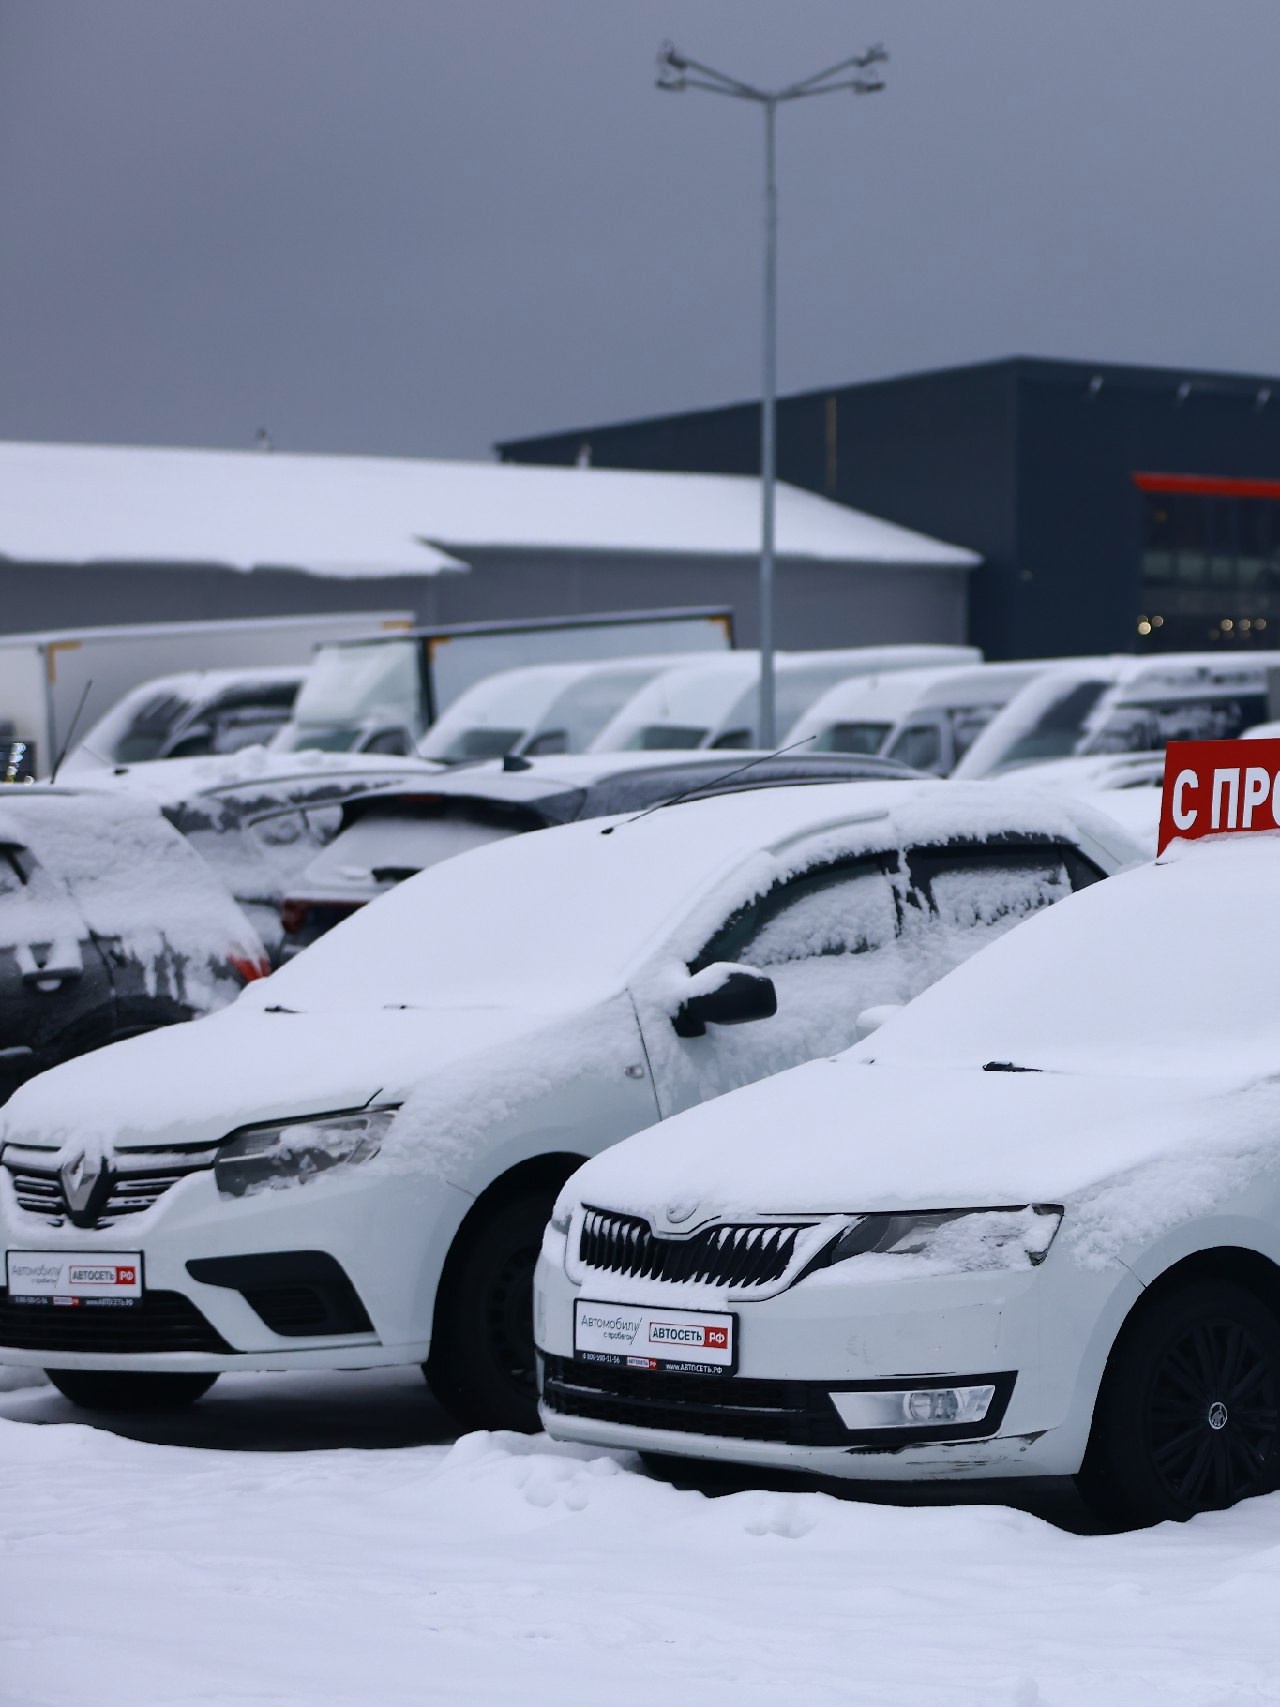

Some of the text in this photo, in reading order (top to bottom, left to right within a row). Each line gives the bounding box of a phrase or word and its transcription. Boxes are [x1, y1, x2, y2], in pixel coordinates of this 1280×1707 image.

[1172, 769, 1199, 831] С
[72, 1271, 134, 1281] АВТОСЕТЬ РФ
[581, 1315, 640, 1332] Автомобили
[652, 1327, 725, 1344] АВТОСЕТЬ РФ
